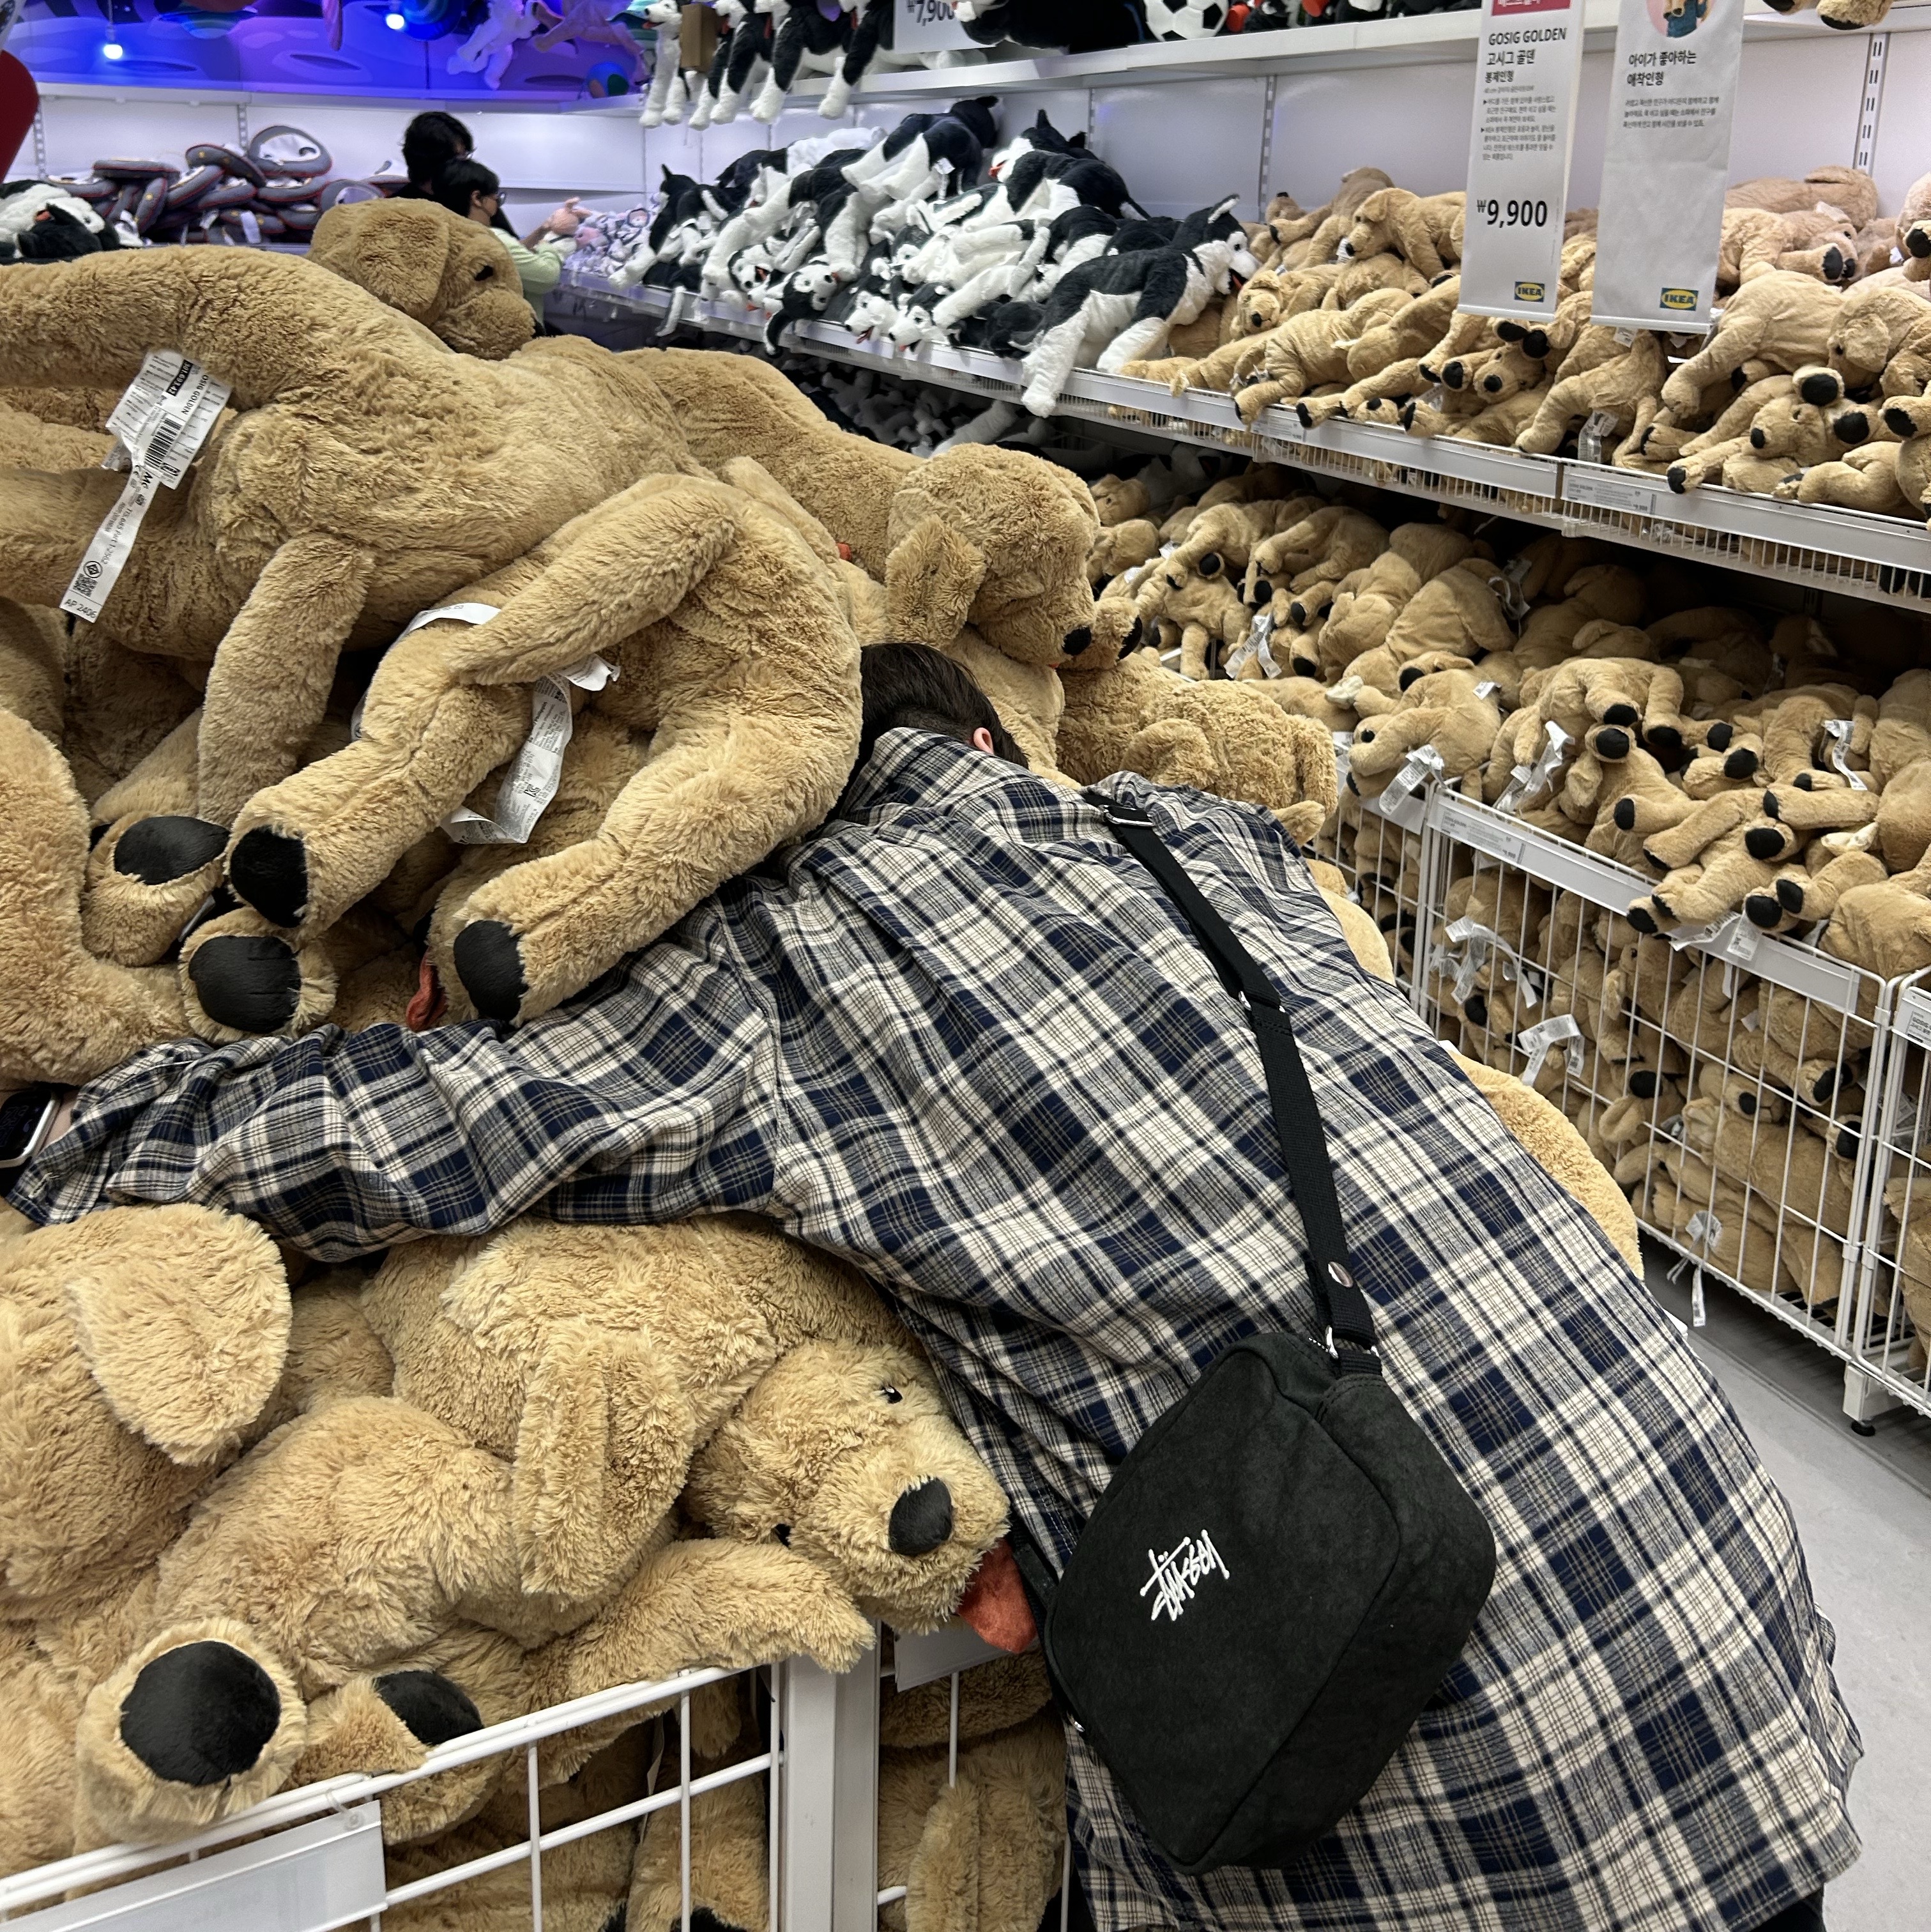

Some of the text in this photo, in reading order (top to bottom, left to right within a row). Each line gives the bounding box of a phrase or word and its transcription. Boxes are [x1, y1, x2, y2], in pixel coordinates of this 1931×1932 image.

[1488, 27, 1567, 45] GOSIG GOLDEN
[1486, 50, 1515, 66] 고시그
[1629, 50, 1697, 67] 아이가 좋아하는
[1485, 70, 1514, 84] 봉제인형
[1627, 71, 1664, 87] 애착인형
[1476, 199, 1548, 229] ₩9,900
[181, 374, 210, 415] OSIG GOLDEN
